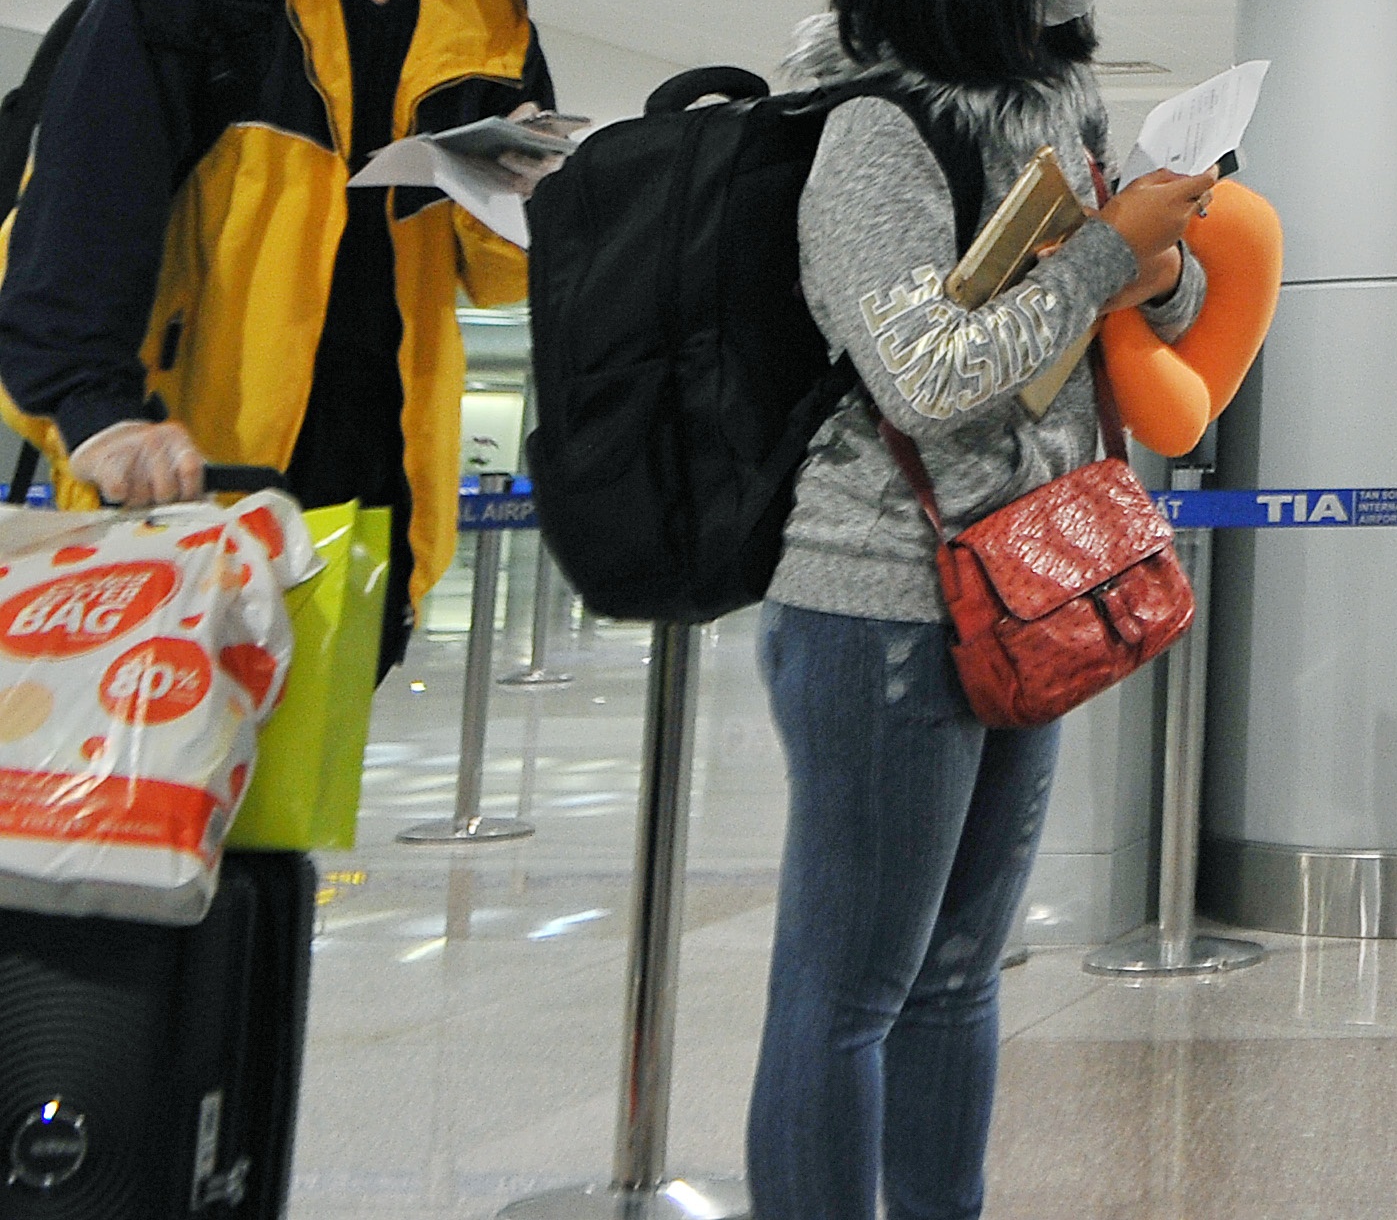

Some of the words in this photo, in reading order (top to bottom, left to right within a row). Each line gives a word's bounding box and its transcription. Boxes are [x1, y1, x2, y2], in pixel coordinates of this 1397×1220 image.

[1256, 494, 1348, 523] TIA
[1360, 490, 1379, 500] TAN
[7, 602, 127, 637] BAG
